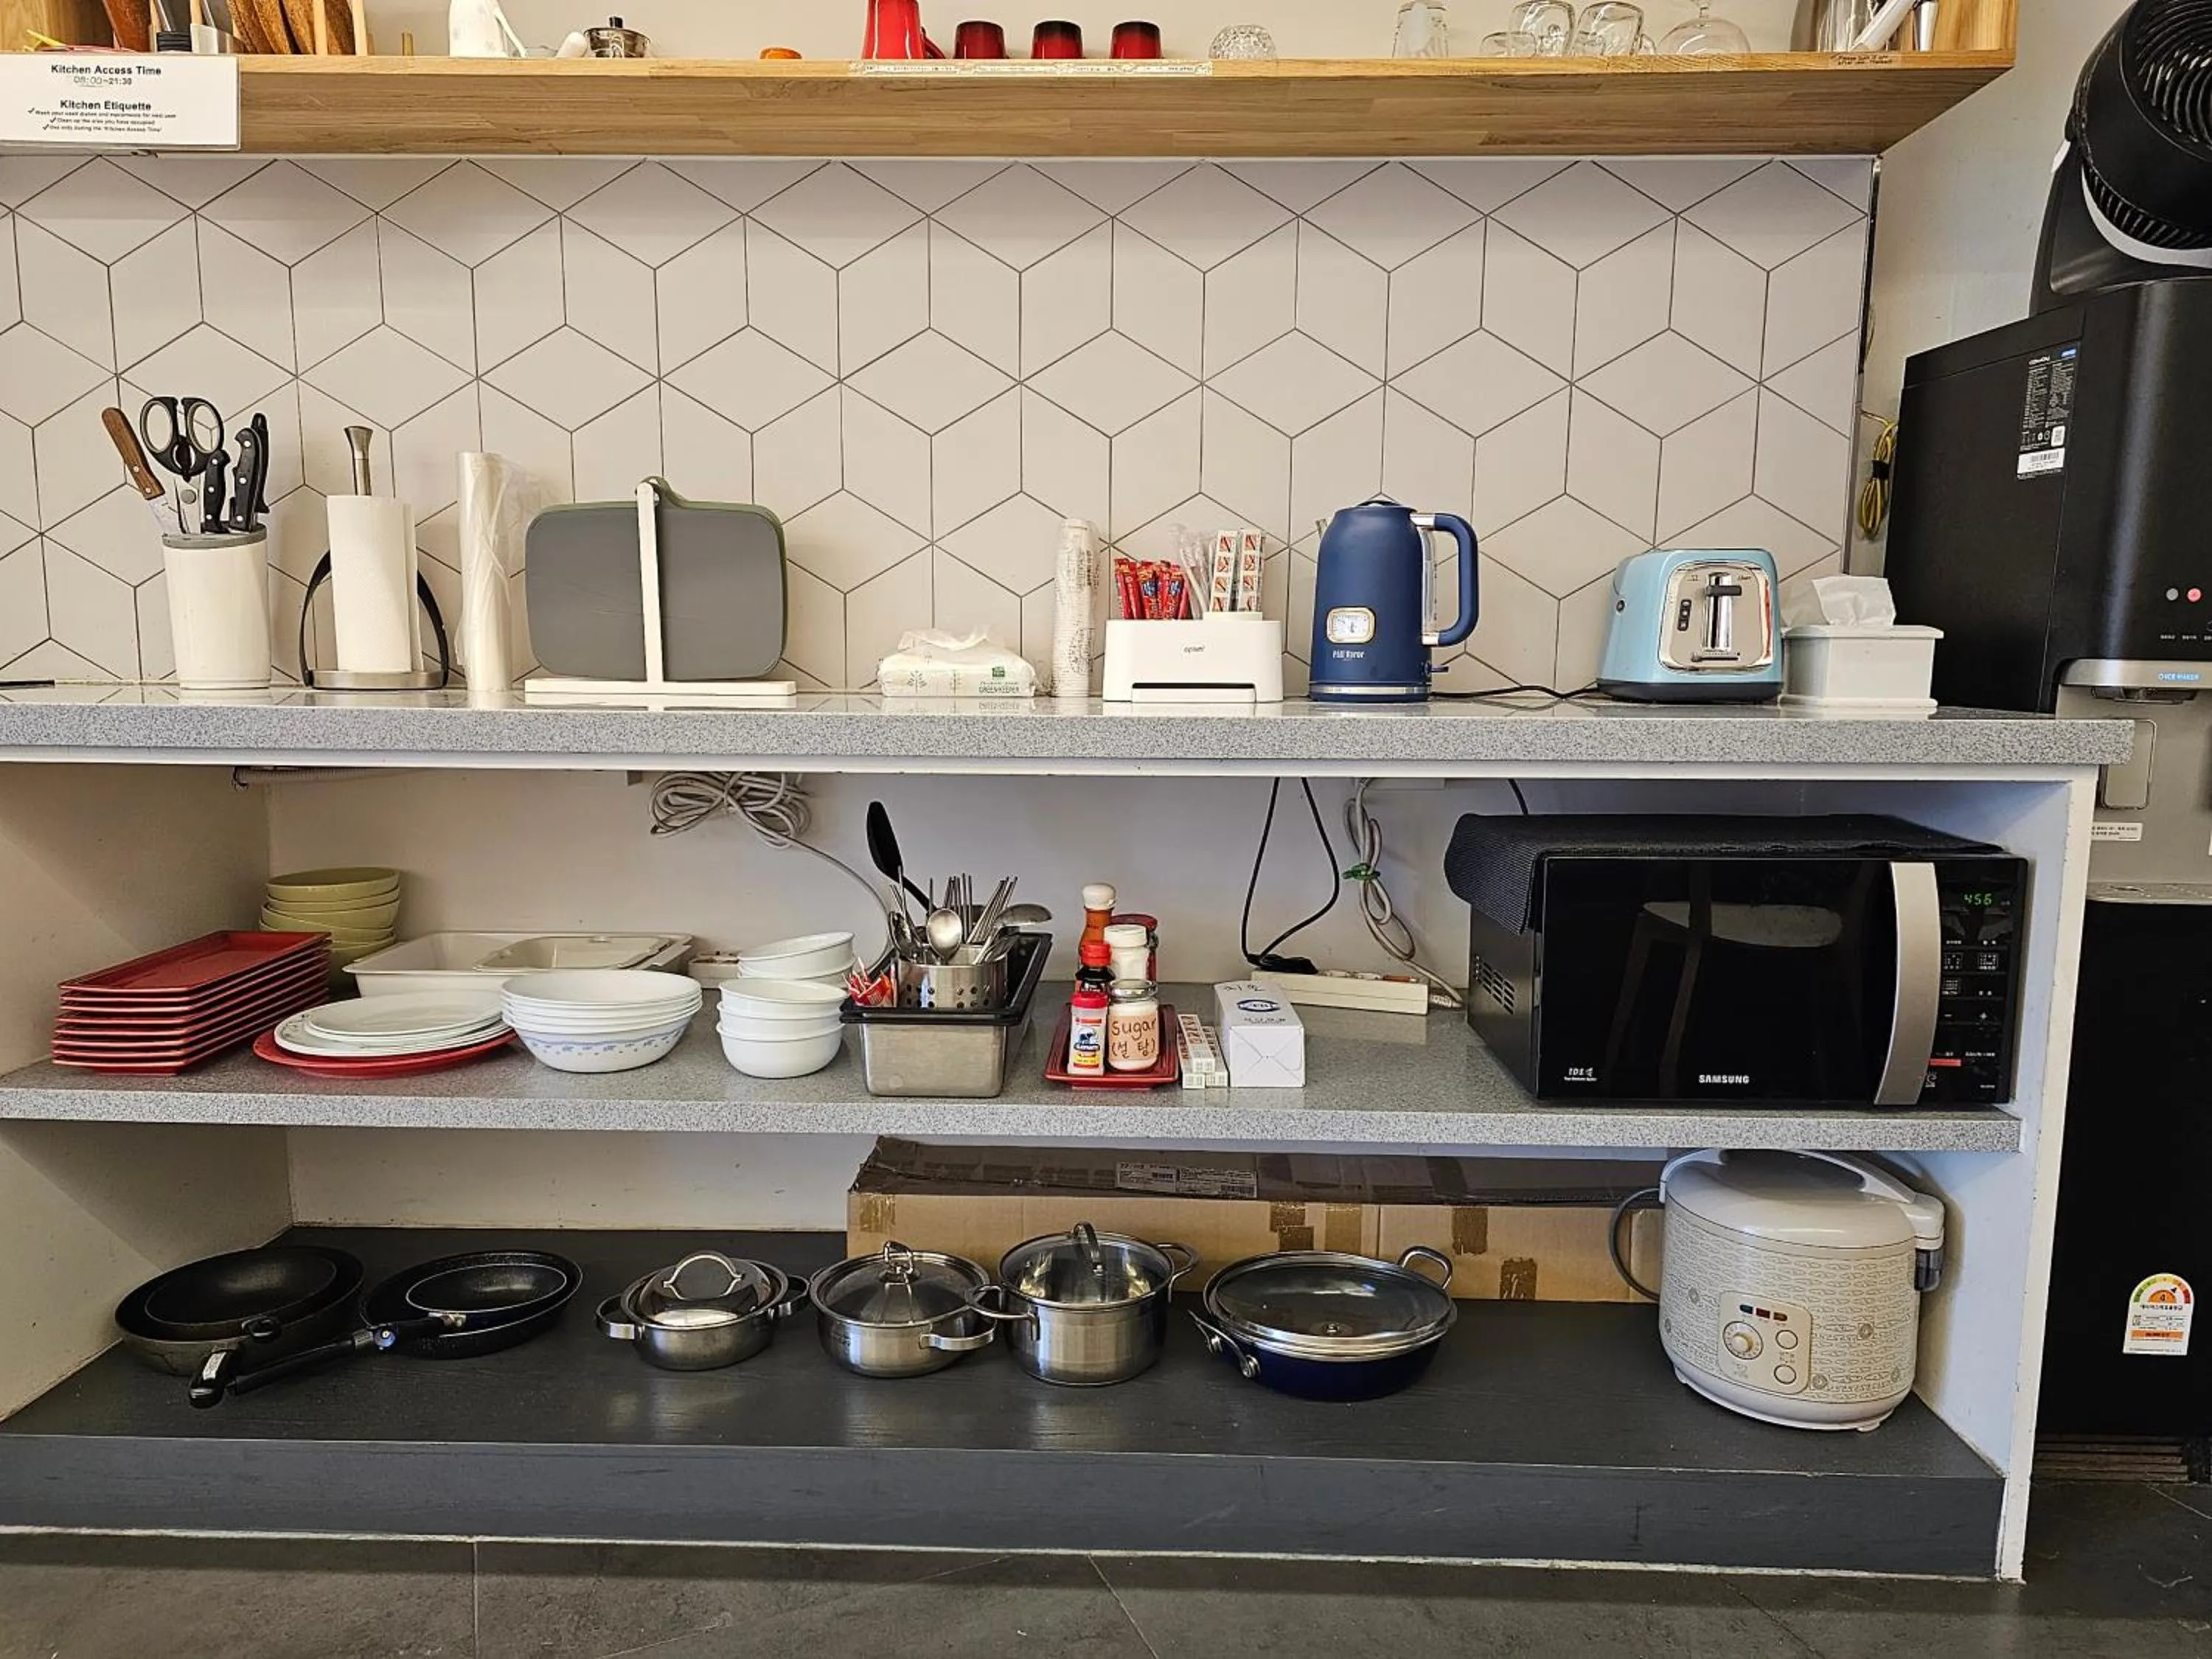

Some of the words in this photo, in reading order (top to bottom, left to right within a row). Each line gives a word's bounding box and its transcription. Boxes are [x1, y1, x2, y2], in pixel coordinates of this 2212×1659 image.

[51, 64, 91, 74] Kitchen
[94, 65, 133, 74] Access
[136, 66, 161, 75] Time
[60, 100, 101, 109] Kitchen
[104, 100, 151, 111] Etiquette
[1111, 1018, 1157, 1041] Sugar
[1698, 1074, 1750, 1084] SAMSUNG
